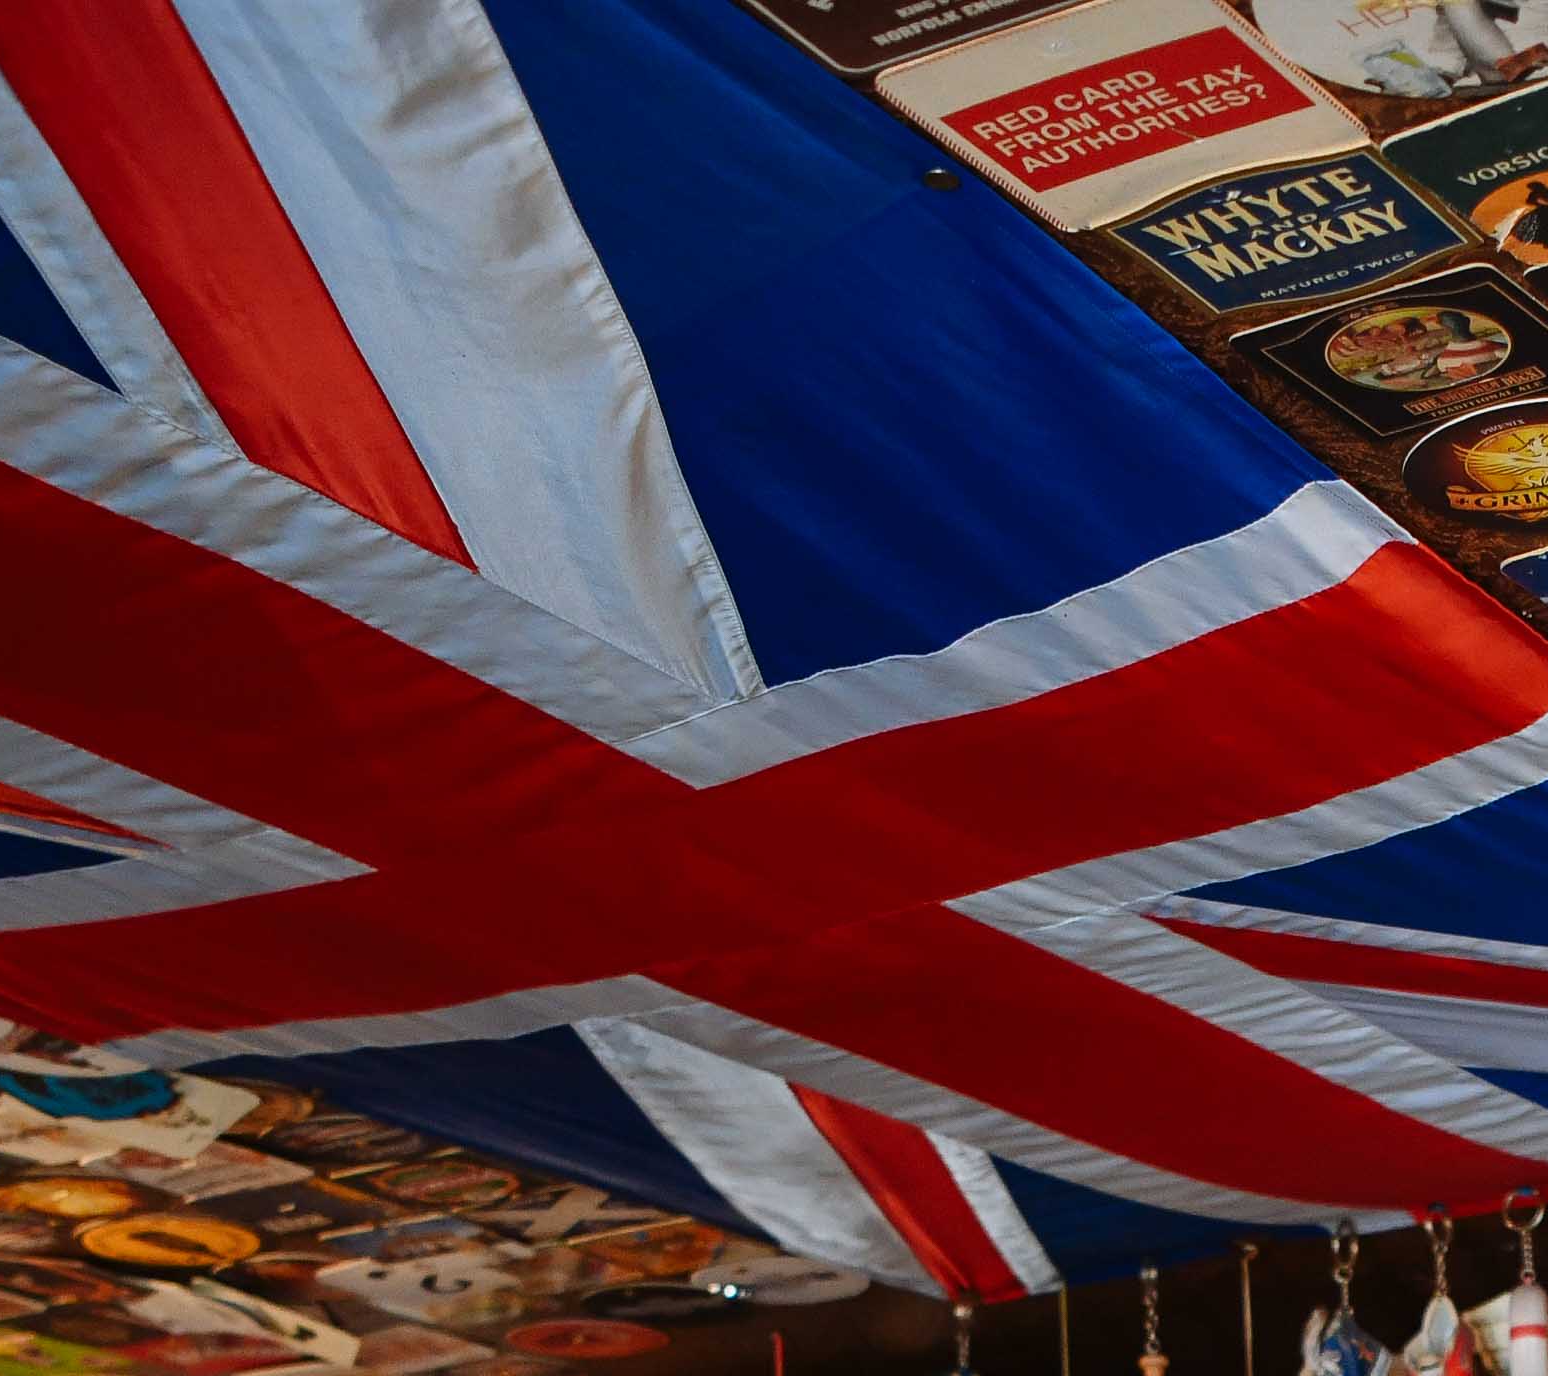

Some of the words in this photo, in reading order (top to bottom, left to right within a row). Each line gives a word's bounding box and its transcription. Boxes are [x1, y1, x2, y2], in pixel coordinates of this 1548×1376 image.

[973, 105, 1050, 141] RED
[1052, 70, 1157, 115] CARD
[994, 113, 1098, 157] FROM
[1104, 87, 1178, 124] THE
[1181, 65, 1255, 95] TAX
[1020, 83, 1270, 174] AUTHORITIES?
[1141, 166, 1373, 251] WHYTE
[1184, 201, 1410, 284] MACKAY
[1248, 212, 1320, 238] AND
[1260, 268, 1351, 299] MATURED
[1353, 248, 1418, 273] TWICE
